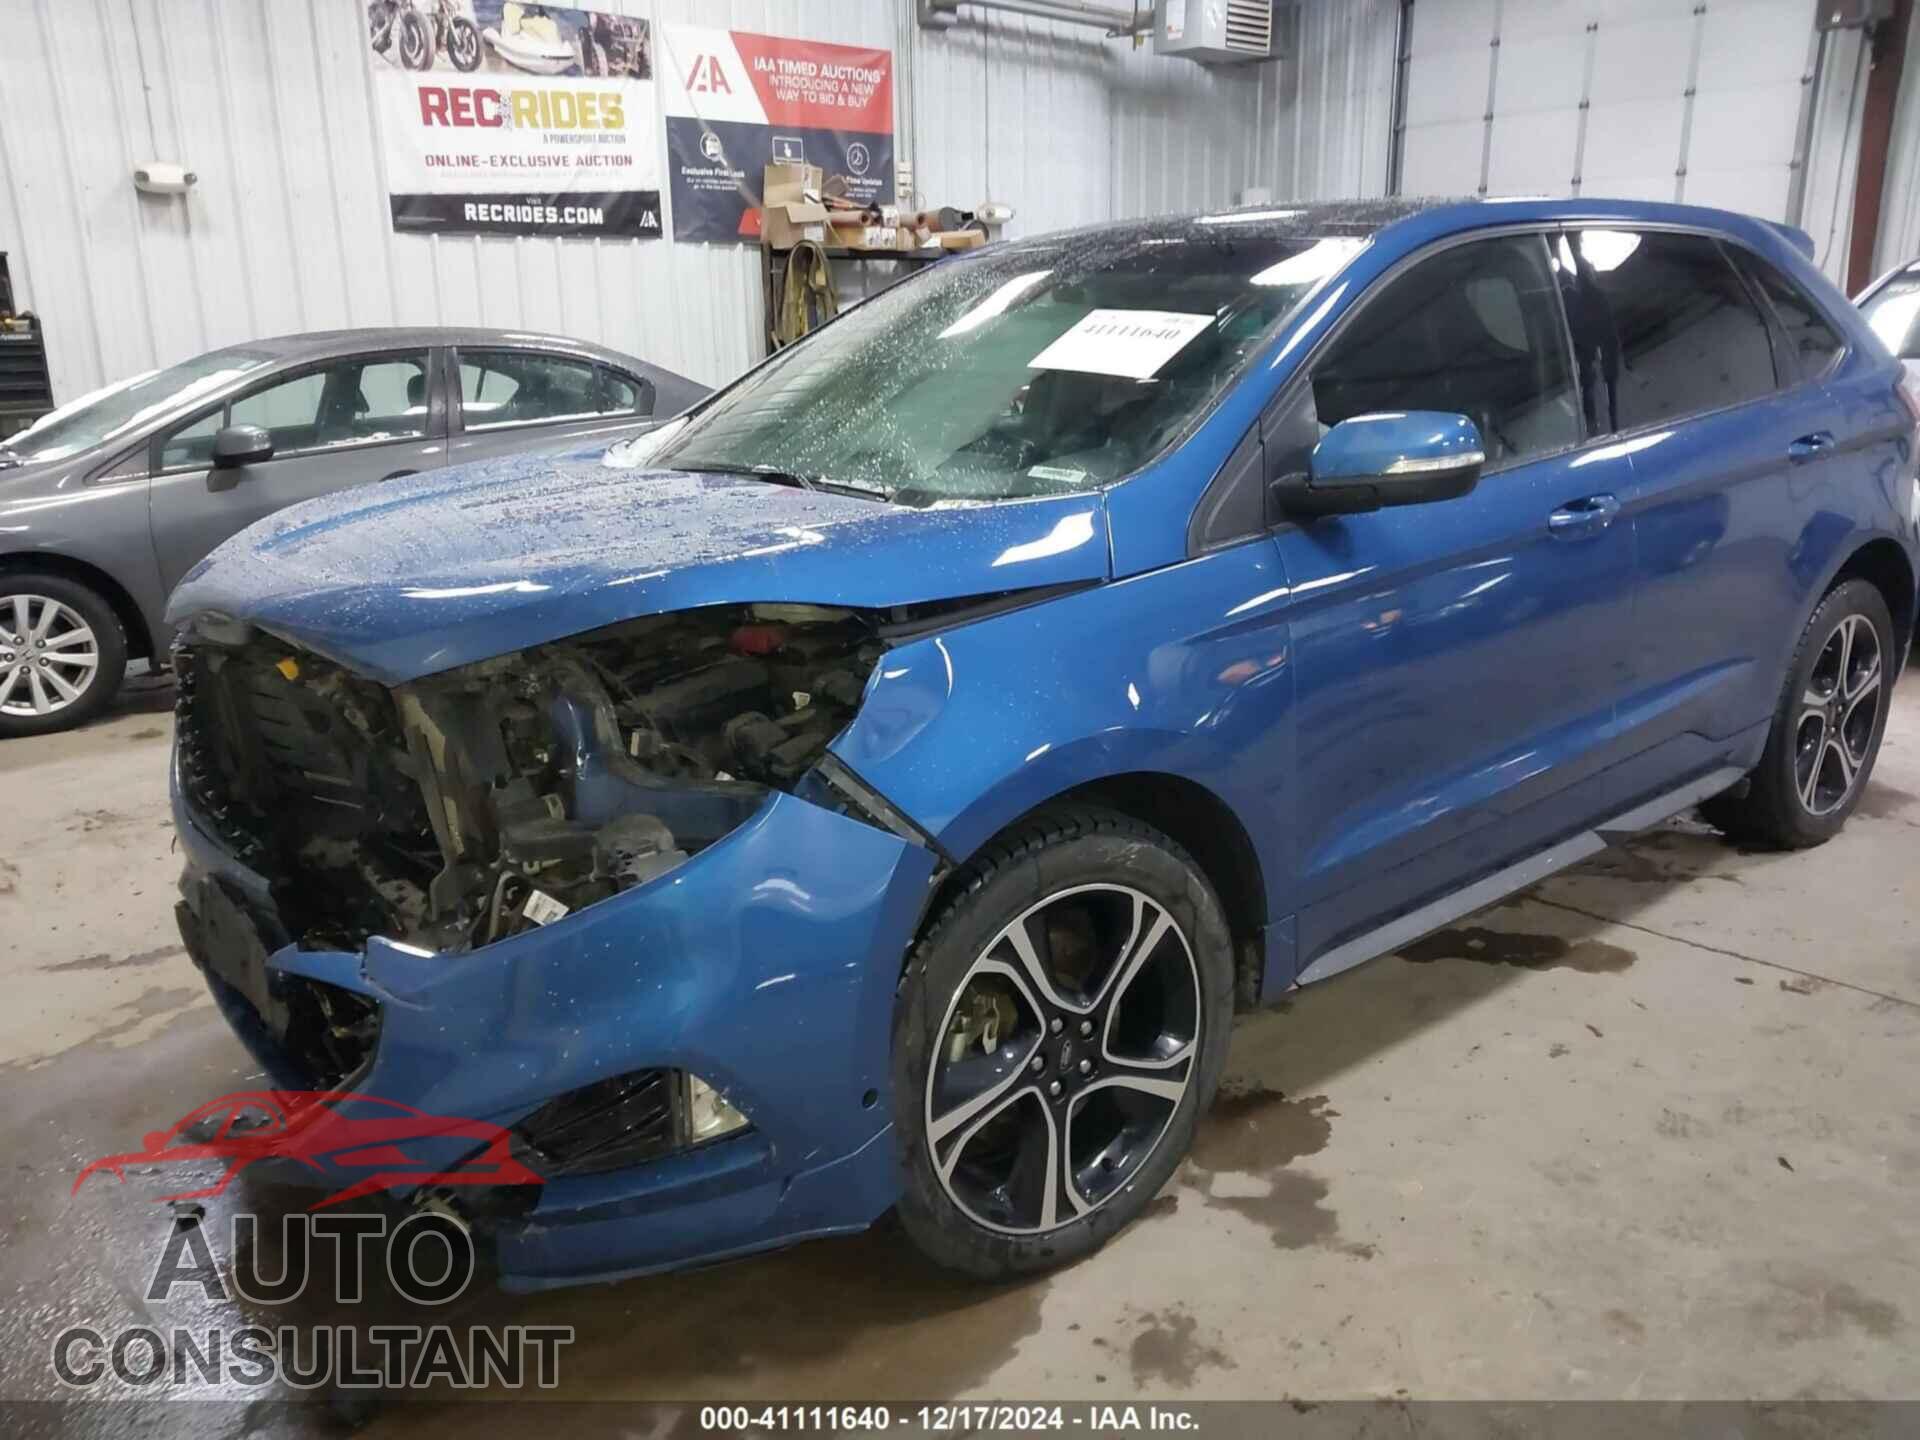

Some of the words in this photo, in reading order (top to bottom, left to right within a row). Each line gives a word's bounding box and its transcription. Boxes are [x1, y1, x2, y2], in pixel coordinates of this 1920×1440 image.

[753, 56, 776, 73] IAA
[776, 58, 817, 77] TIMED
[820, 63, 881, 84] AUCTIONS
[768, 74, 840, 93] INTRODUCING
[841, 81, 850, 93] A
[851, 82, 874, 96] NEW
[775, 88, 800, 102] WAY
[802, 90, 818, 103] TO
[819, 92, 835, 105] BID
[837, 94, 847, 106] &
[848, 95, 869, 108] BUY
[425, 154, 571, 168] ONLINE-EXCLUSIVE
[576, 155, 633, 167] AUCTION
[464, 203, 604, 225] RECRIDES.COM
